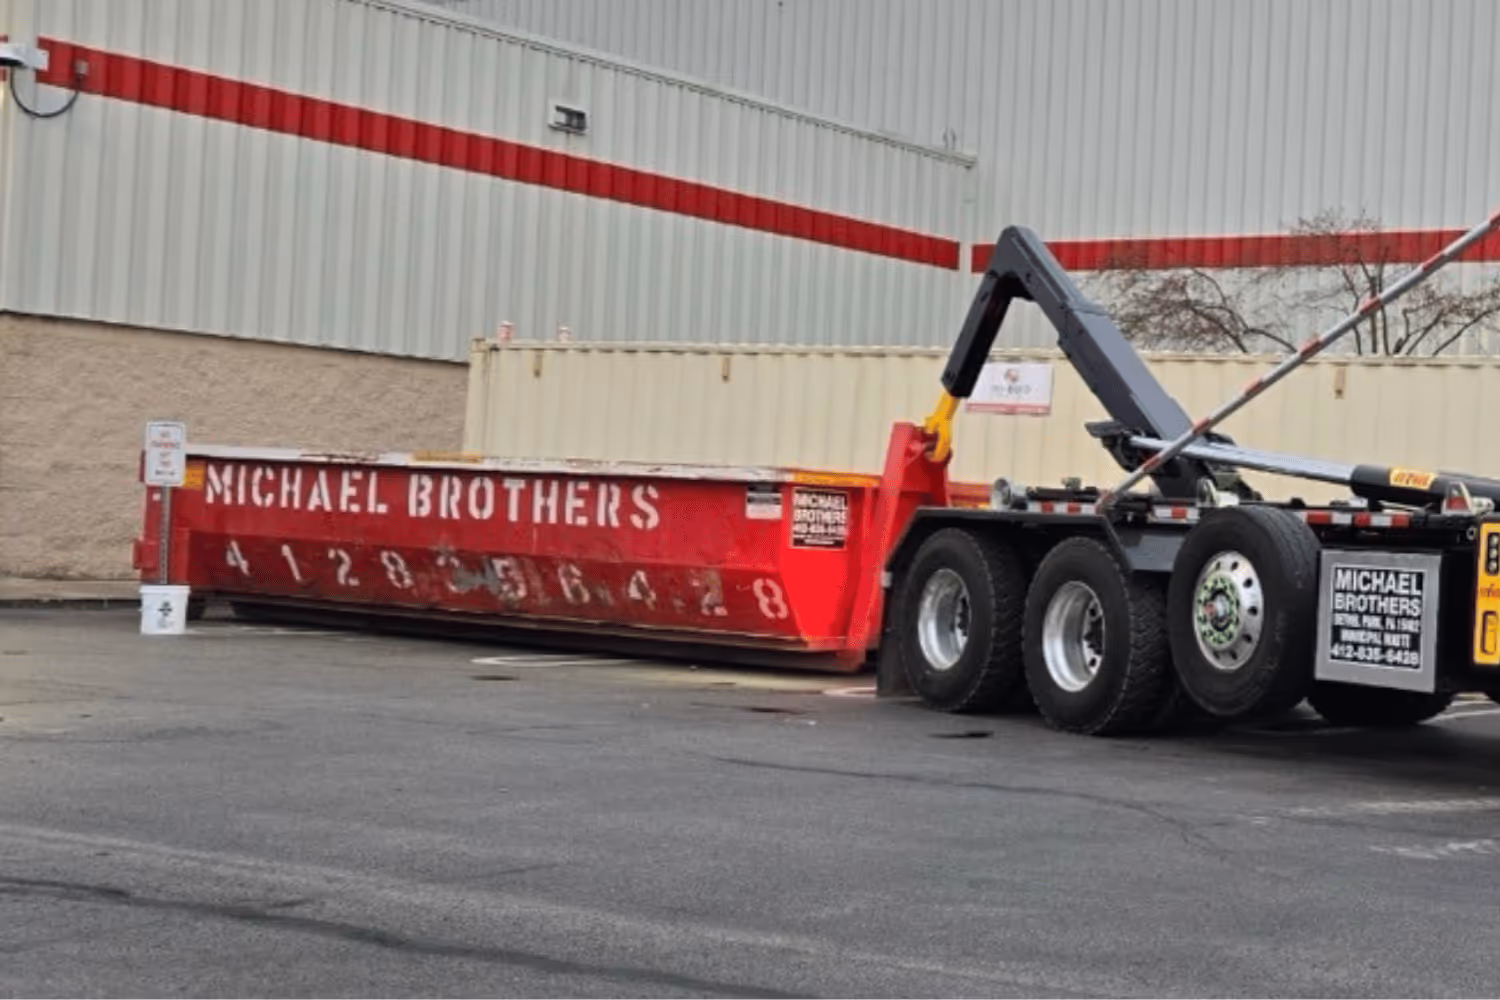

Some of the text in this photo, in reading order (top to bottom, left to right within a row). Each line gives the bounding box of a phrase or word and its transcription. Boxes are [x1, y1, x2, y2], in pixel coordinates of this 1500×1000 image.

[204, 463, 662, 530] MICHAEL BROTHERS
[793, 492, 846, 511] MICHAEL
[793, 508, 848, 525] BROTHERS
[1336, 568, 1422, 595] MICHAEL
[1335, 592, 1421, 617] BROTHERS
[1331, 643, 1420, 666] 412-835-6428
